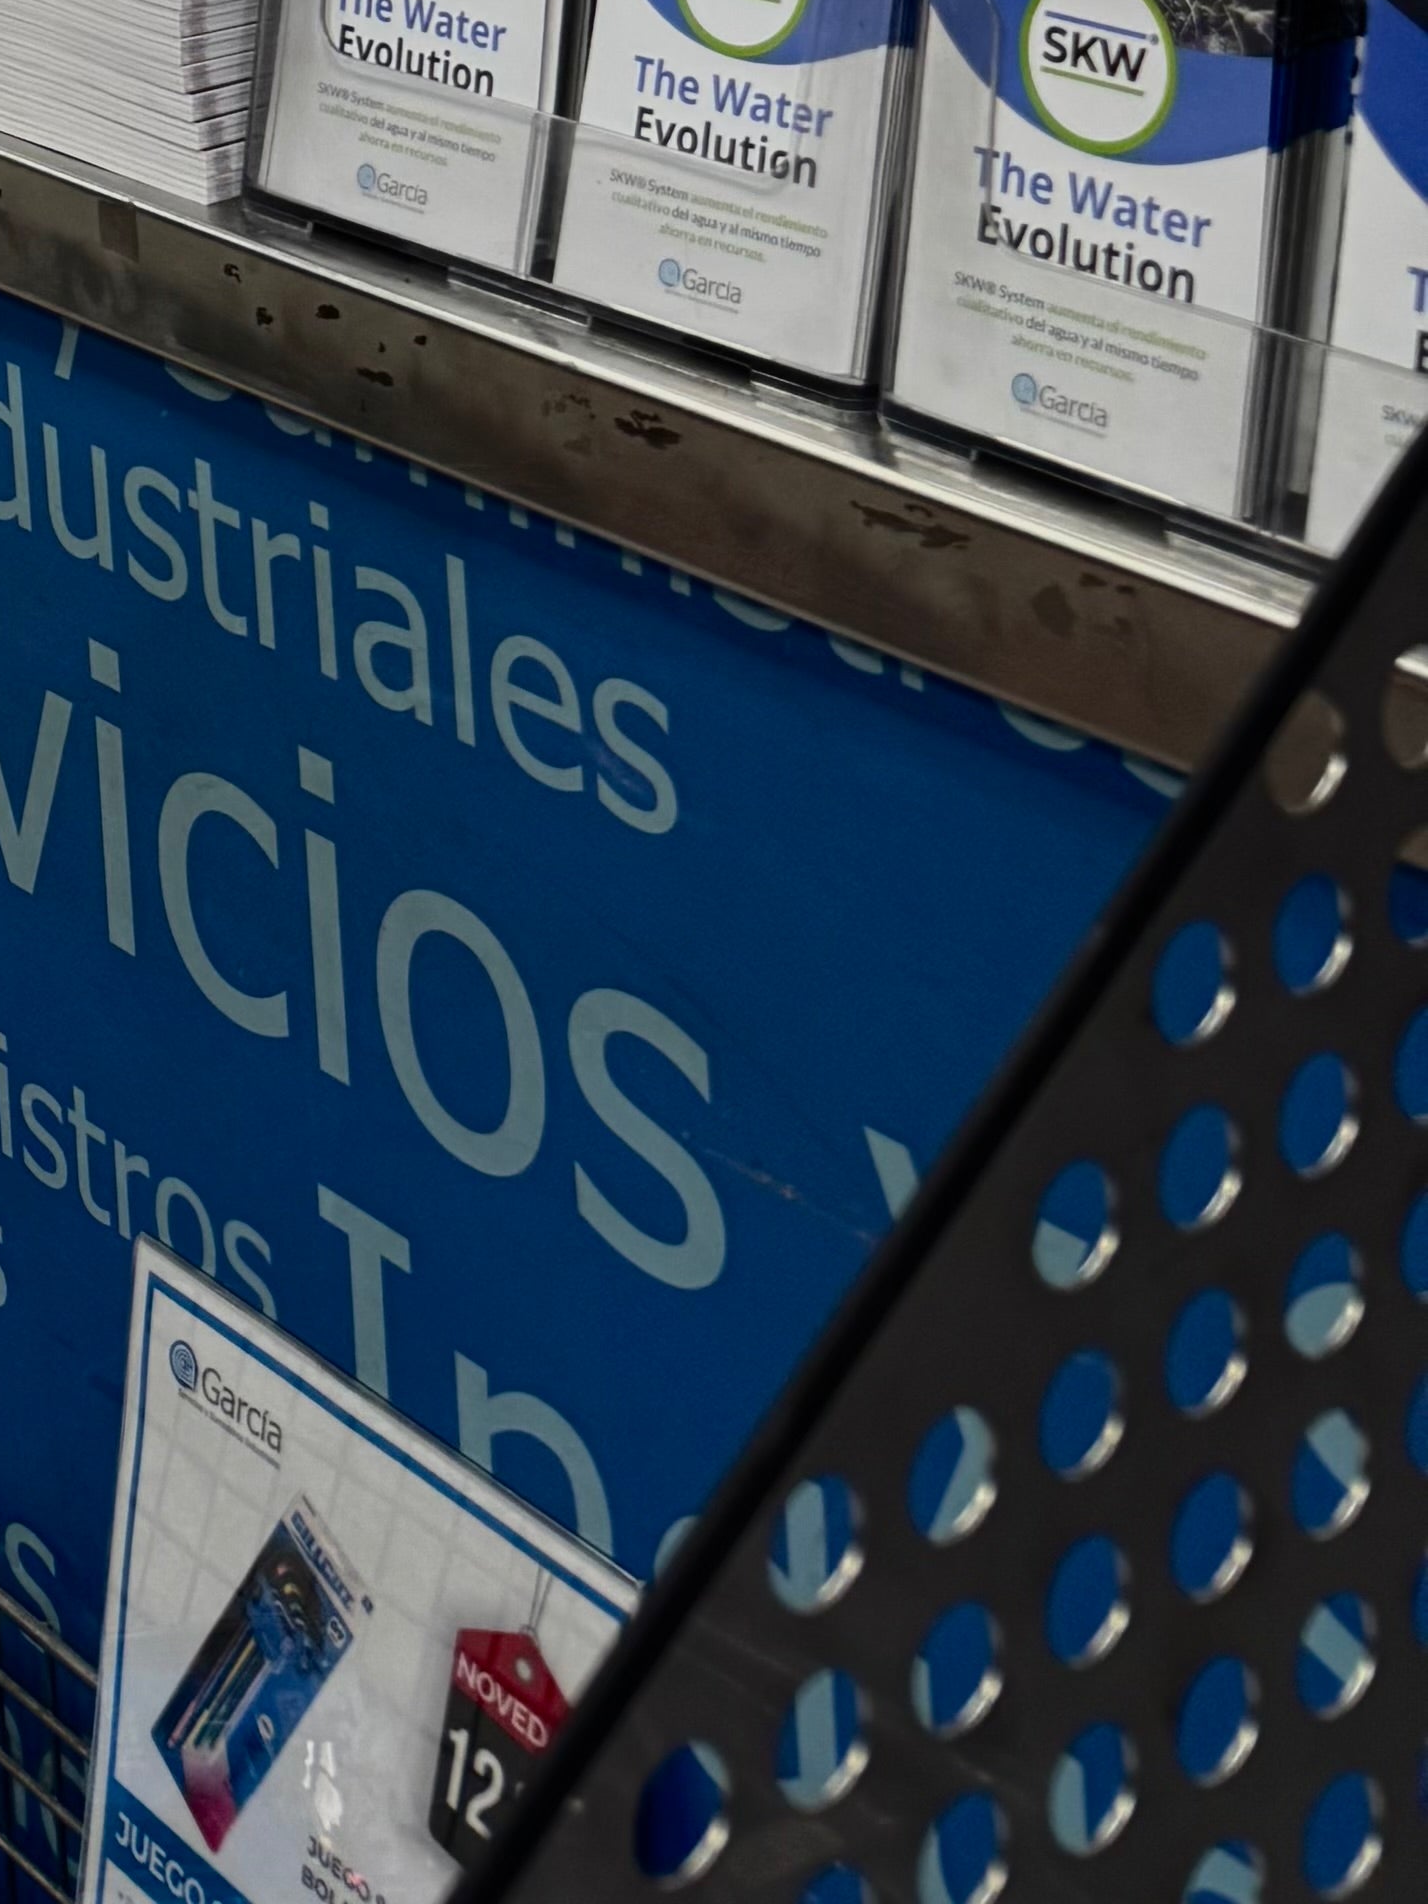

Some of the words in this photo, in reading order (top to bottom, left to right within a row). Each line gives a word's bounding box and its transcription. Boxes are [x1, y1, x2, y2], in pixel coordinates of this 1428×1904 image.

[335, 22, 496, 98] Evolution
[1039, 21, 1148, 85] SKW
[633, 55, 701, 104] The
[712, 74, 834, 138] Water
[633, 104, 818, 190] Evolution
[974, 147, 1059, 211] The
[1066, 162, 1213, 251] Water
[976, 204, 1198, 306] Evolution
[998, 283, 1045, 311] System
[202, 1365, 285, 1455] García
[455, 1654, 550, 1751] NOVED
